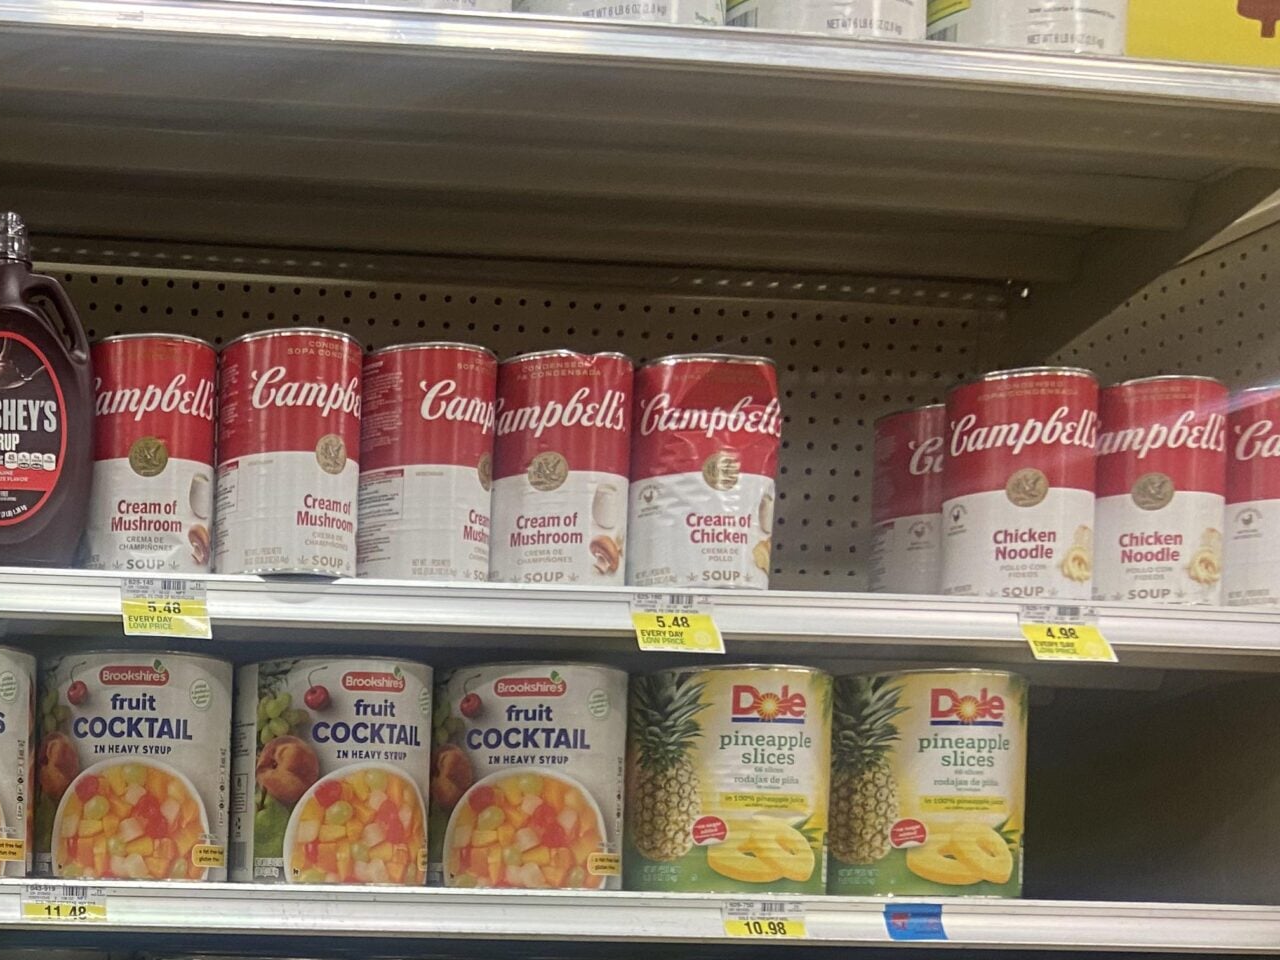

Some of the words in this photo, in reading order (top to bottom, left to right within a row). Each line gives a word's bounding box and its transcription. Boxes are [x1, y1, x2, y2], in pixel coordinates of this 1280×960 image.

[950, 406, 1096, 457] Campbell's
[118, 500, 161, 515] Cream
[164, 500, 177, 515] of
[111, 516, 182, 533] Mushroom
[690, 529, 748, 545] Chicken
[993, 529, 1056, 544] Chicken
[995, 545, 1054, 561] Noodle
[1121, 548, 1180, 564] Noodle
[126, 559, 165, 570] SOUP
[128, 615, 154, 623] EVERY
[156, 616, 173, 624] DAY
[656, 615, 690, 628] 5.48
[1046, 627, 1078, 640] 4.98
[110, 693, 156, 711] fruit
[732, 685, 807, 718] Dole
[73, 716, 192, 741] COCKTAIL
[312, 721, 421, 747] COCKTAIL
[720, 730, 811, 750] pineapple
[918, 733, 1010, 753] pineapple
[741, 749, 795, 765] slices
[941, 752, 995, 767] slices
[734, 775, 768, 786] rodajas
[771, 775, 781, 785] de
[744, 921, 787, 937] 10.98
